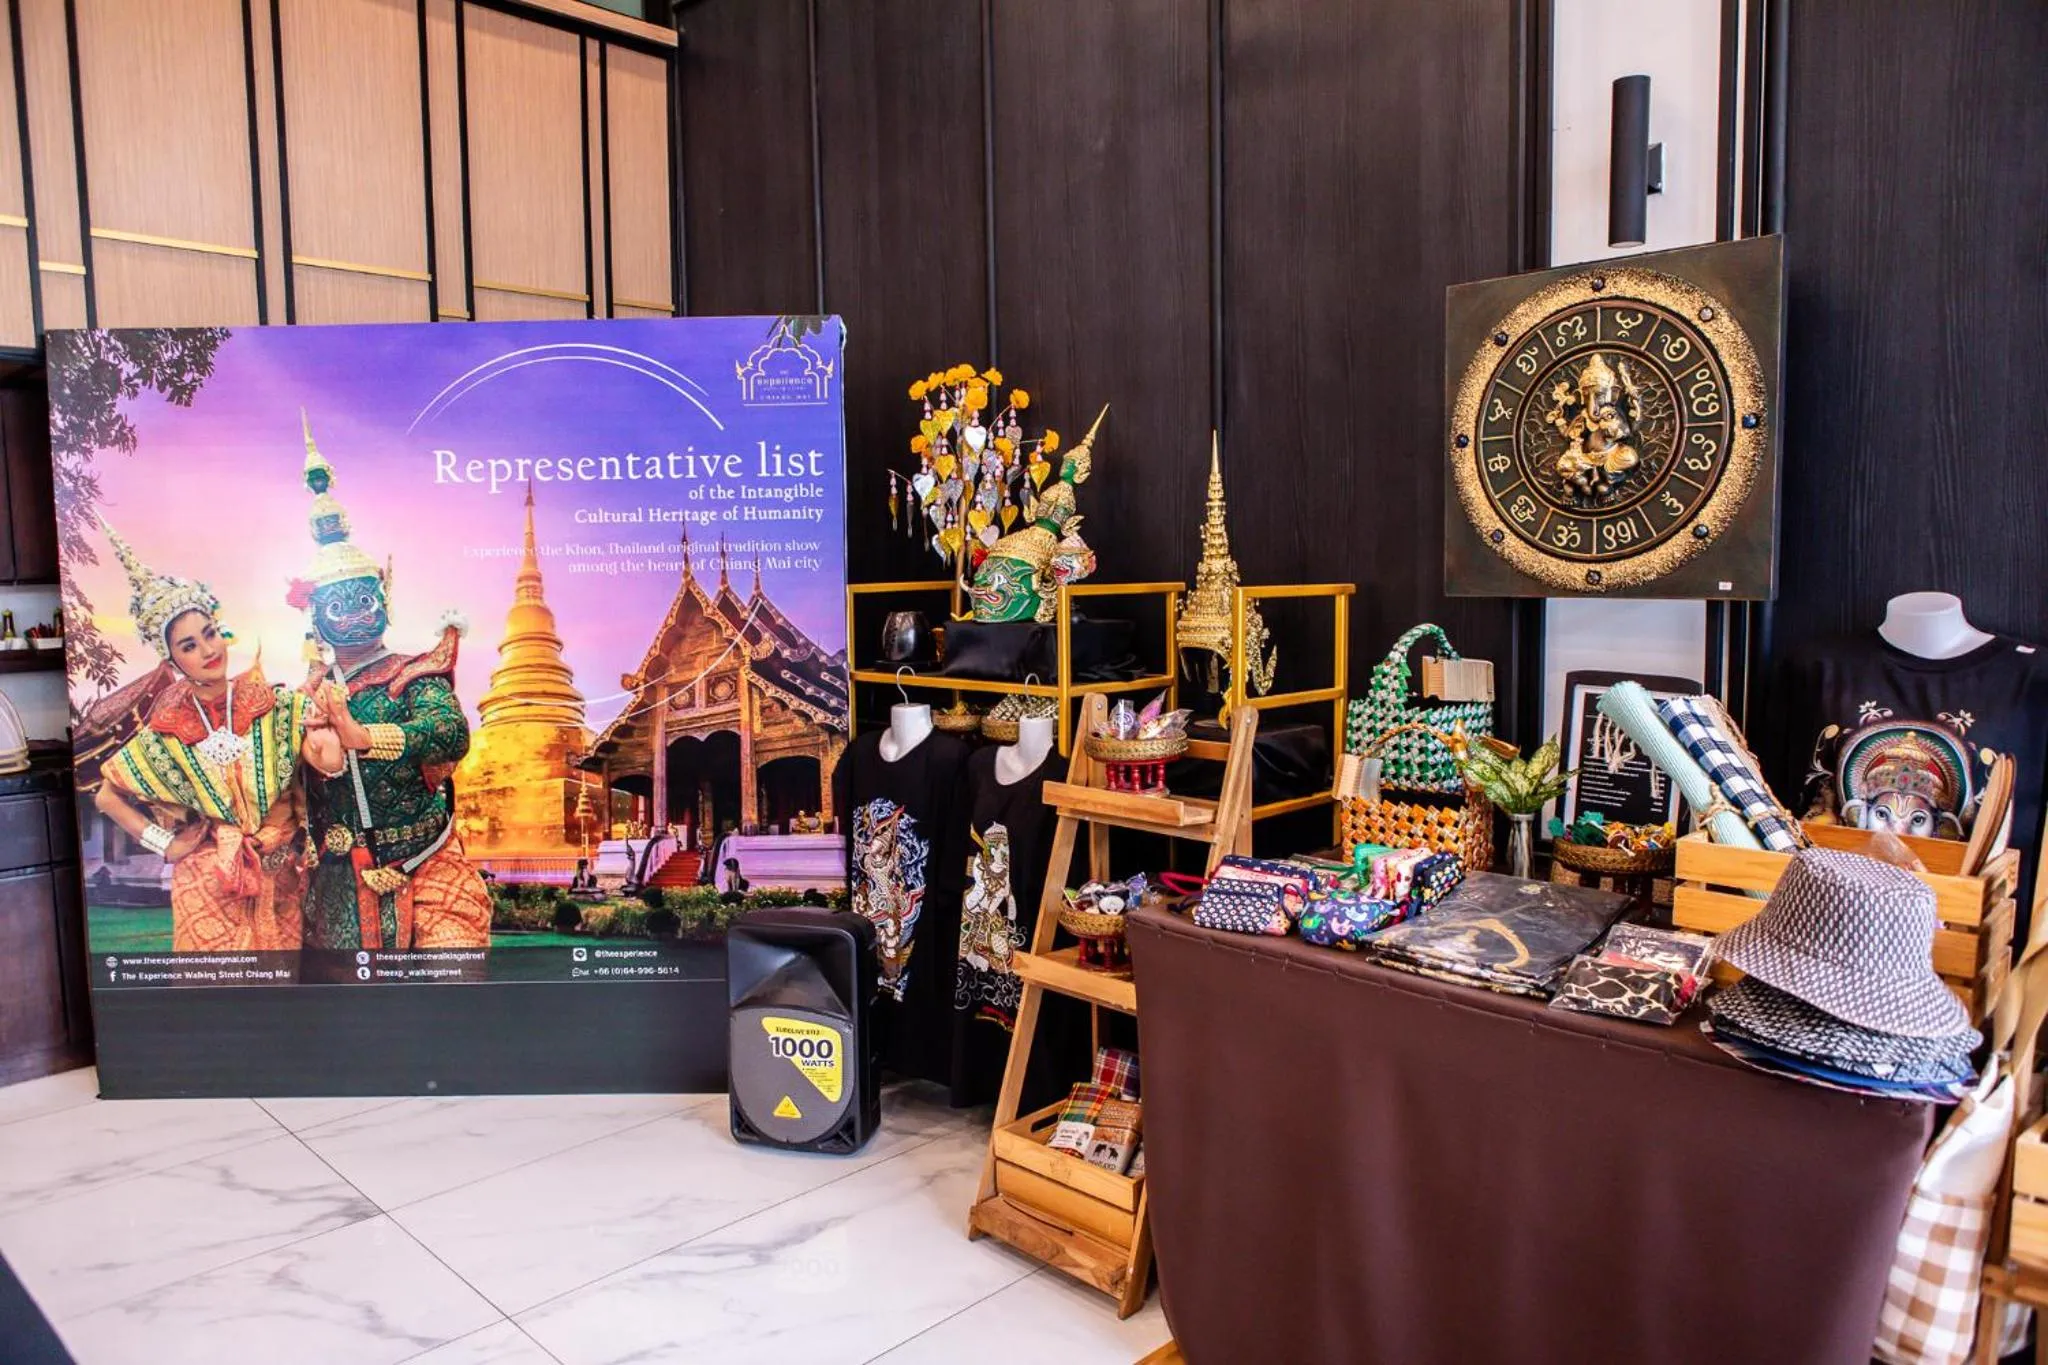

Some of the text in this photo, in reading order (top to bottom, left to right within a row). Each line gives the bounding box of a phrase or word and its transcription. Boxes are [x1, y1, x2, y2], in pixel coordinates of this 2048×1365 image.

[433, 441, 825, 494] Representative list
[688, 483, 824, 503] of the Intangible
[574, 505, 824, 526] Cultural Heritage of Humanity
[463, 545, 539, 561] Experien
[541, 544, 562, 557] the
[609, 542, 665, 555] Thailand
[668, 540, 719, 556] original
[723, 539, 782, 553] tradition
[784, 539, 821, 552] show
[568, 561, 618, 576] among
[620, 559, 645, 572] the
[691, 558, 708, 570] of
[709, 557, 761, 573] Chiang
[765, 556, 791, 569] Mai
[794, 555, 822, 572] city
[122, 970, 291, 981] The Experience Walking Street Chiang Mai
[770, 1036, 834, 1060] 1000
[801, 1059, 835, 1068] WATTS
